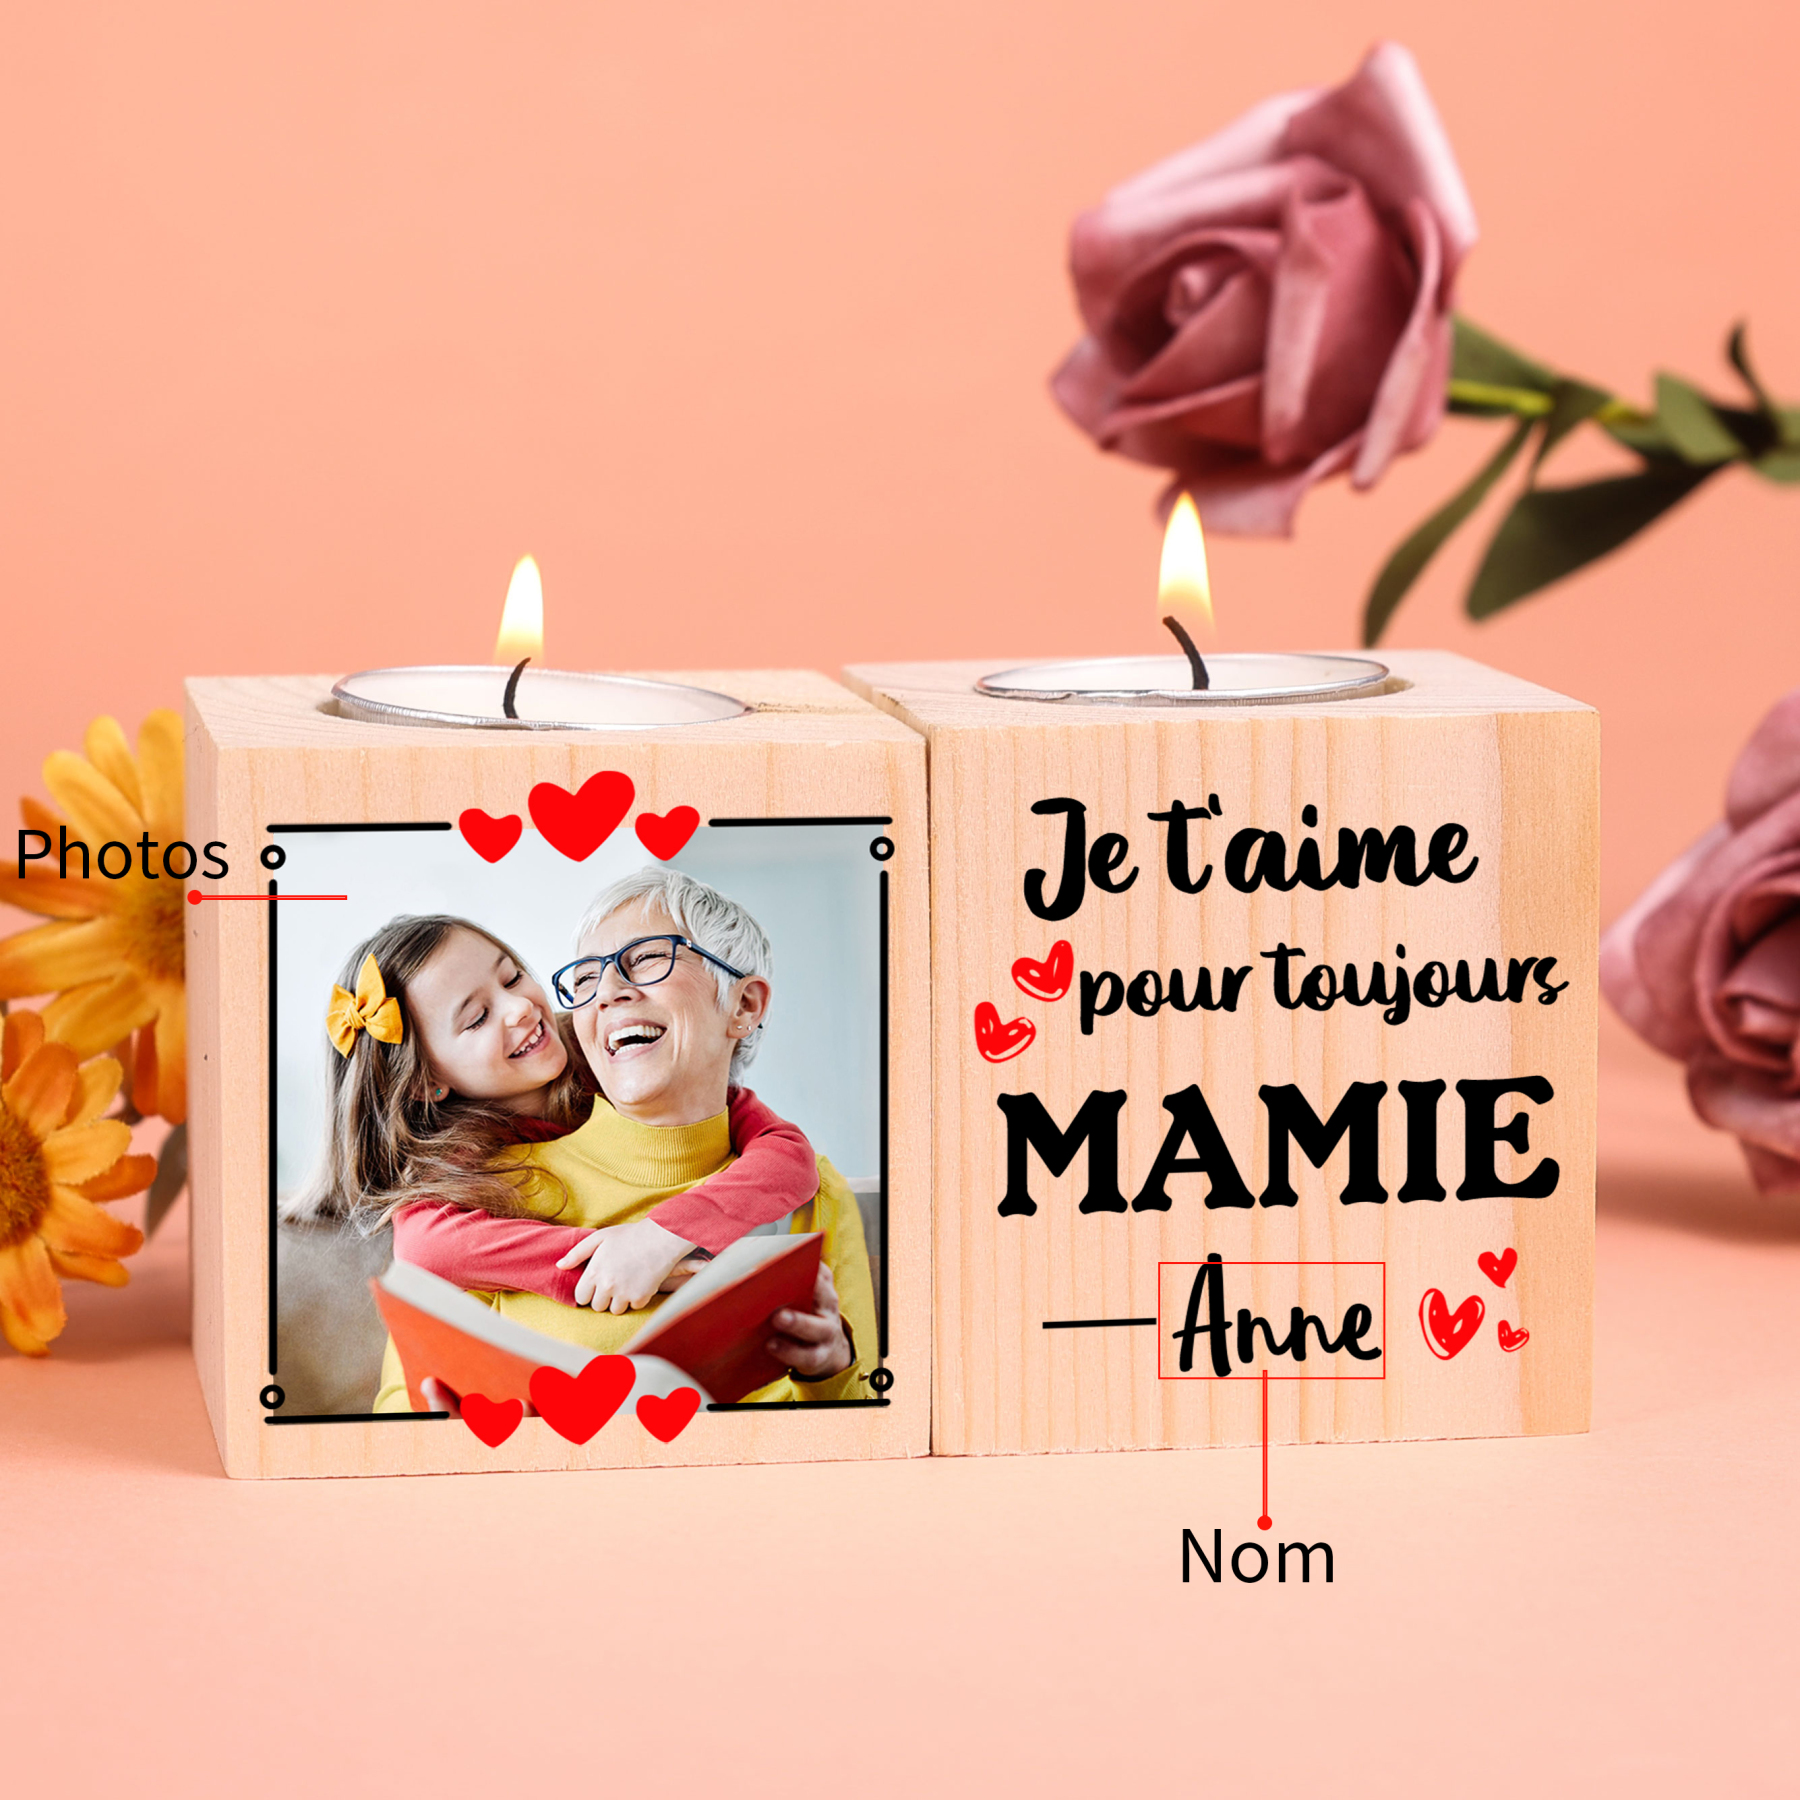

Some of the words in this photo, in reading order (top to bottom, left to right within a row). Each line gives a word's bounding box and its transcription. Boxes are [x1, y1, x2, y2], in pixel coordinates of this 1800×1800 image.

[1023, 797, 1140, 923] Je
[1147, 793, 1480, 895] t'aime
[1079, 963, 1254, 1036] pour
[1259, 942, 1570, 1026] toujours
[996, 1074, 1561, 1218] MAMIE
[1172, 1252, 1382, 1378] Anne
